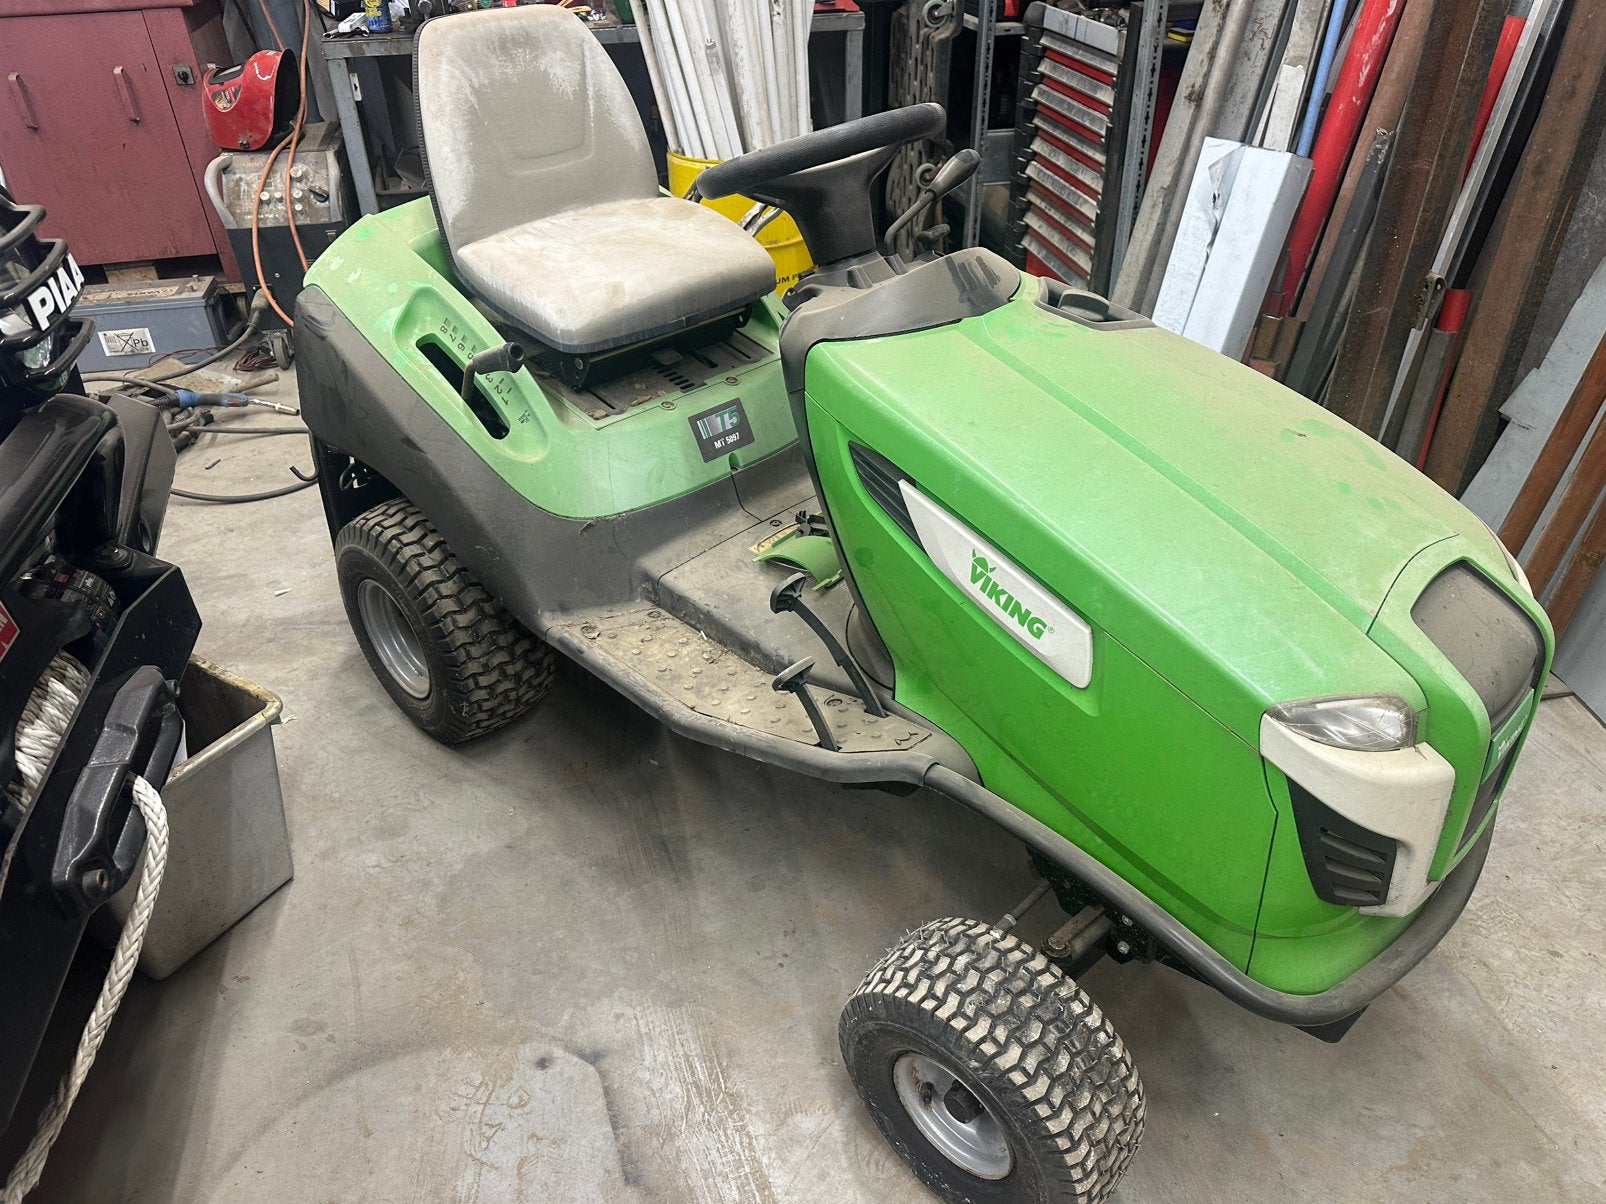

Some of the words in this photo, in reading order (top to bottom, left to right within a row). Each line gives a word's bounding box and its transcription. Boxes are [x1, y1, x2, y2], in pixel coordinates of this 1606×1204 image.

[27, 253, 84, 331] PIAA
[133, 338, 149, 348] Pb
[713, 437, 726, 449] MT
[970, 560, 1047, 640] VIKING
